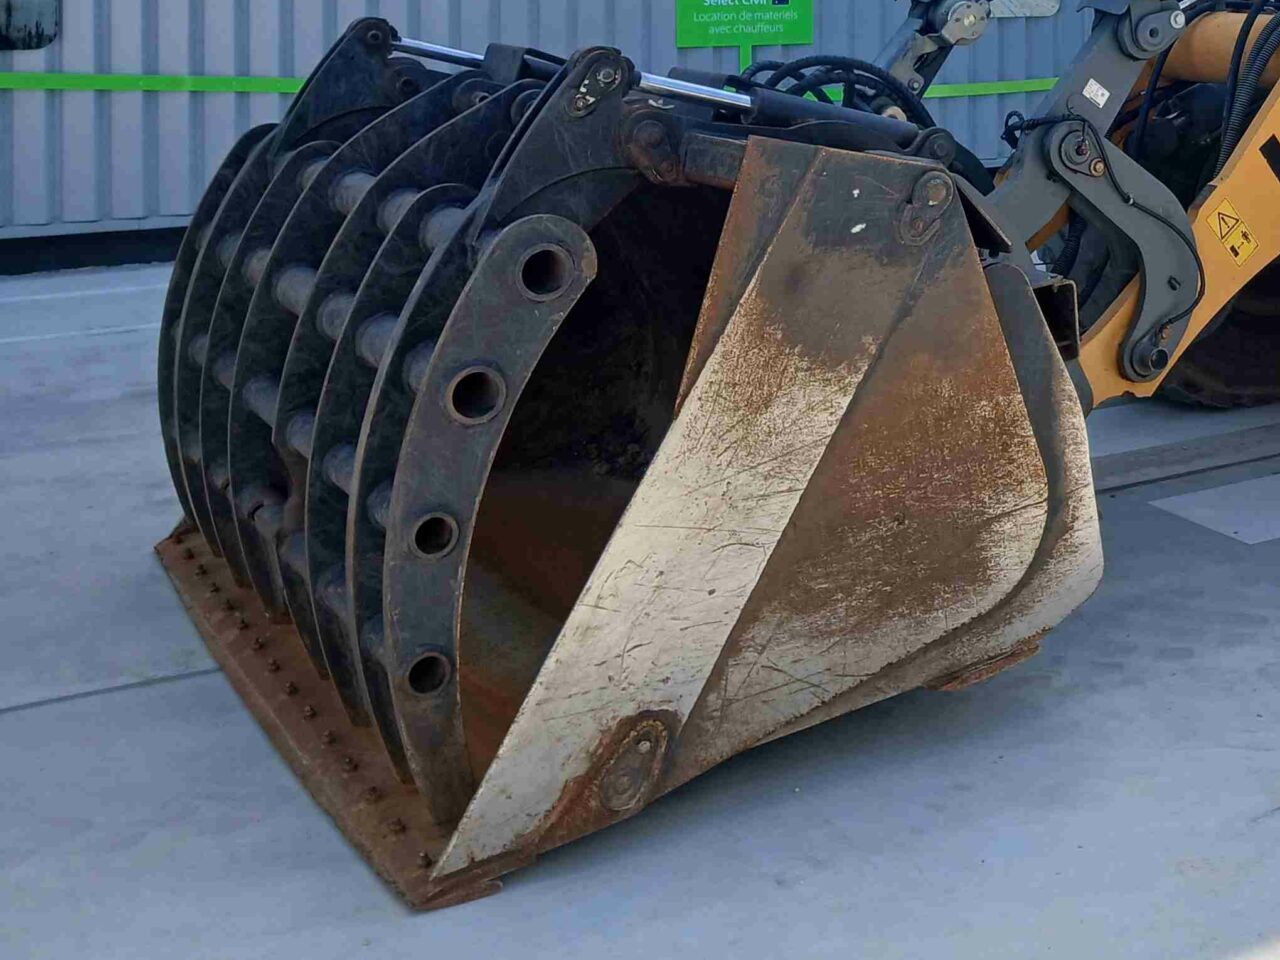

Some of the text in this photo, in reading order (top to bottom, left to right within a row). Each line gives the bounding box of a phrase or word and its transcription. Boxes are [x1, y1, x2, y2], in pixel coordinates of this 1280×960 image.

[693, 11, 737, 22] Location
[738, 10, 752, 22] de
[708, 22, 784, 34] avec chauffeurs
